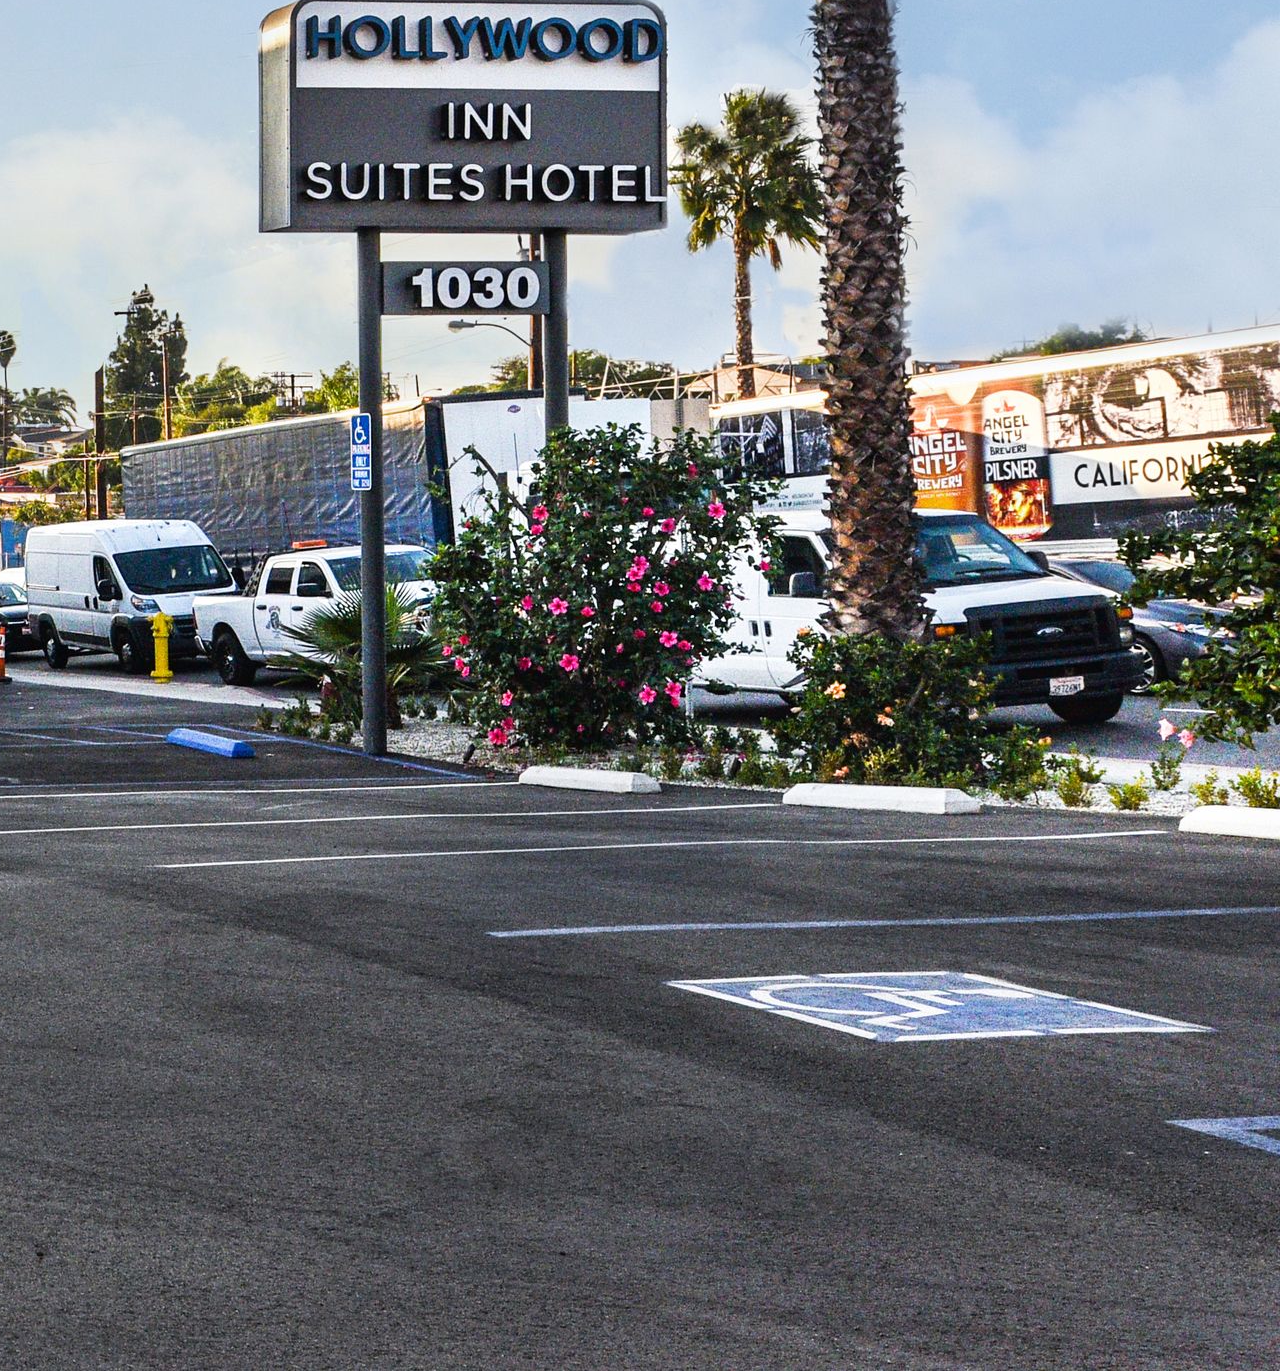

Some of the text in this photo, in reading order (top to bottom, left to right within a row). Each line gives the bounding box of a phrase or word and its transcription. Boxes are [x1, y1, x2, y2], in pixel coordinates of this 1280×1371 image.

[306, 15, 665, 64] HOLLYWOOD
[447, 102, 533, 141] INN
[305, 161, 668, 203] SUITES HOTEL
[410, 266, 541, 310] 1030
[984, 415, 1030, 431] ANGEL
[991, 429, 1023, 444] CITY
[989, 444, 1028, 456] BREWERY
[912, 453, 957, 475] CITY
[985, 459, 1038, 482] PILSNER
[1074, 453, 1206, 489] CALIFORNI
[914, 474, 963, 491] REWERY
